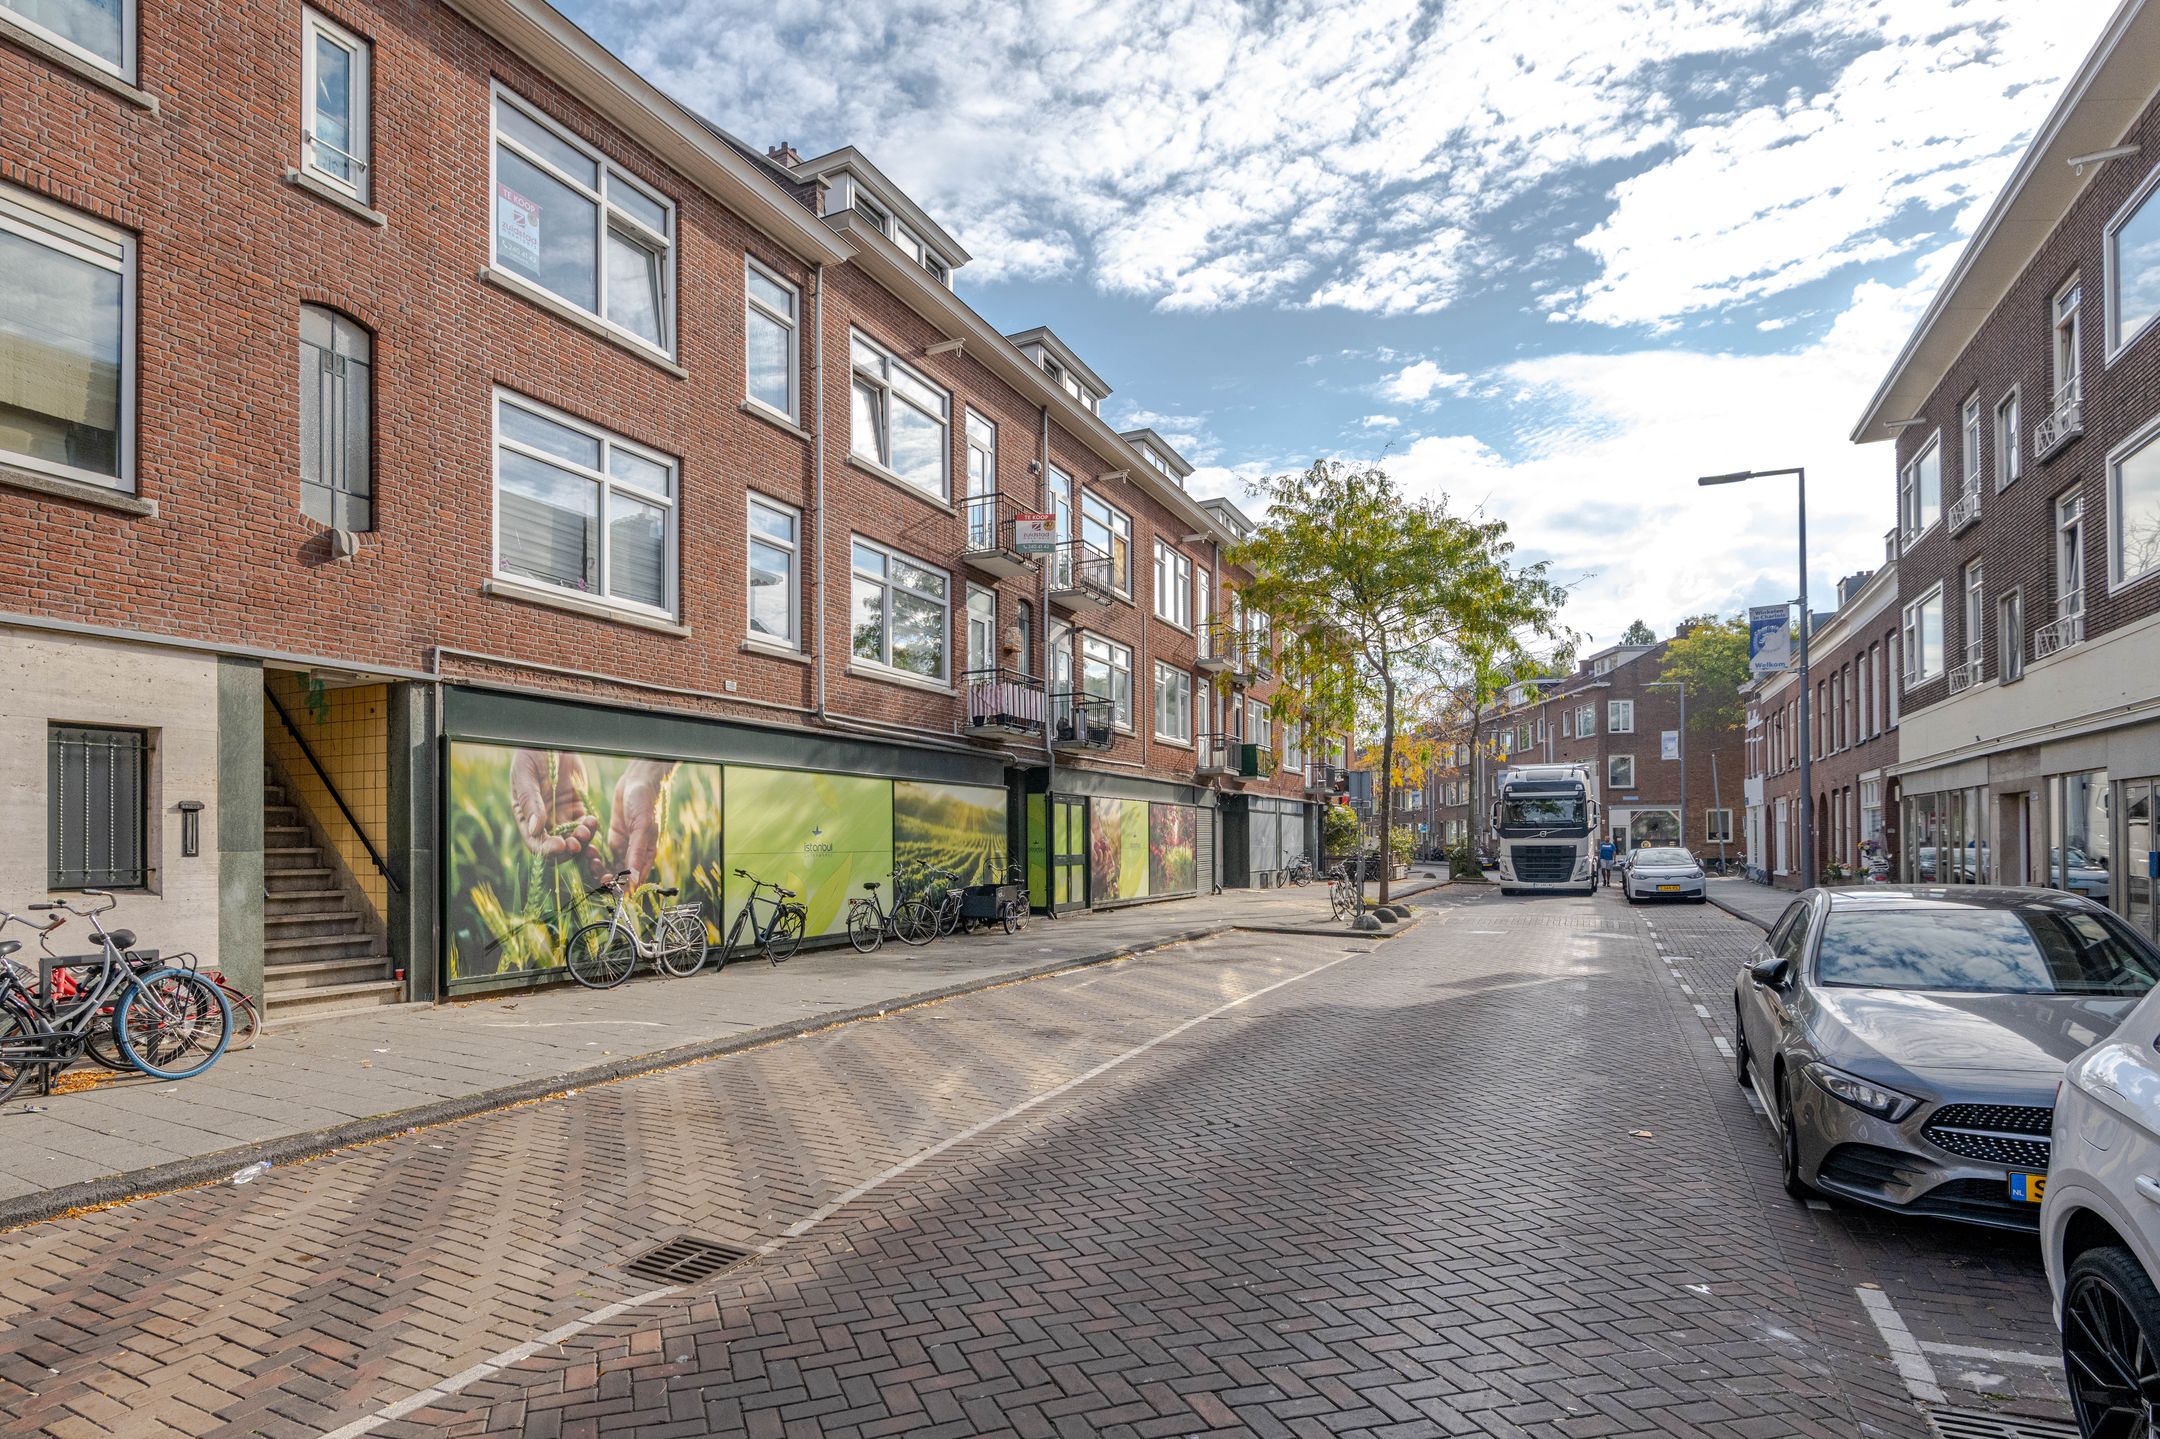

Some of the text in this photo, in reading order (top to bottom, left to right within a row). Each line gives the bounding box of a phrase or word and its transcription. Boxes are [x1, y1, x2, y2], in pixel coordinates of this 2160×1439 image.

[503, 188, 536, 212] TE KOOP
[2012, 1189, 2024, 1197] NL
